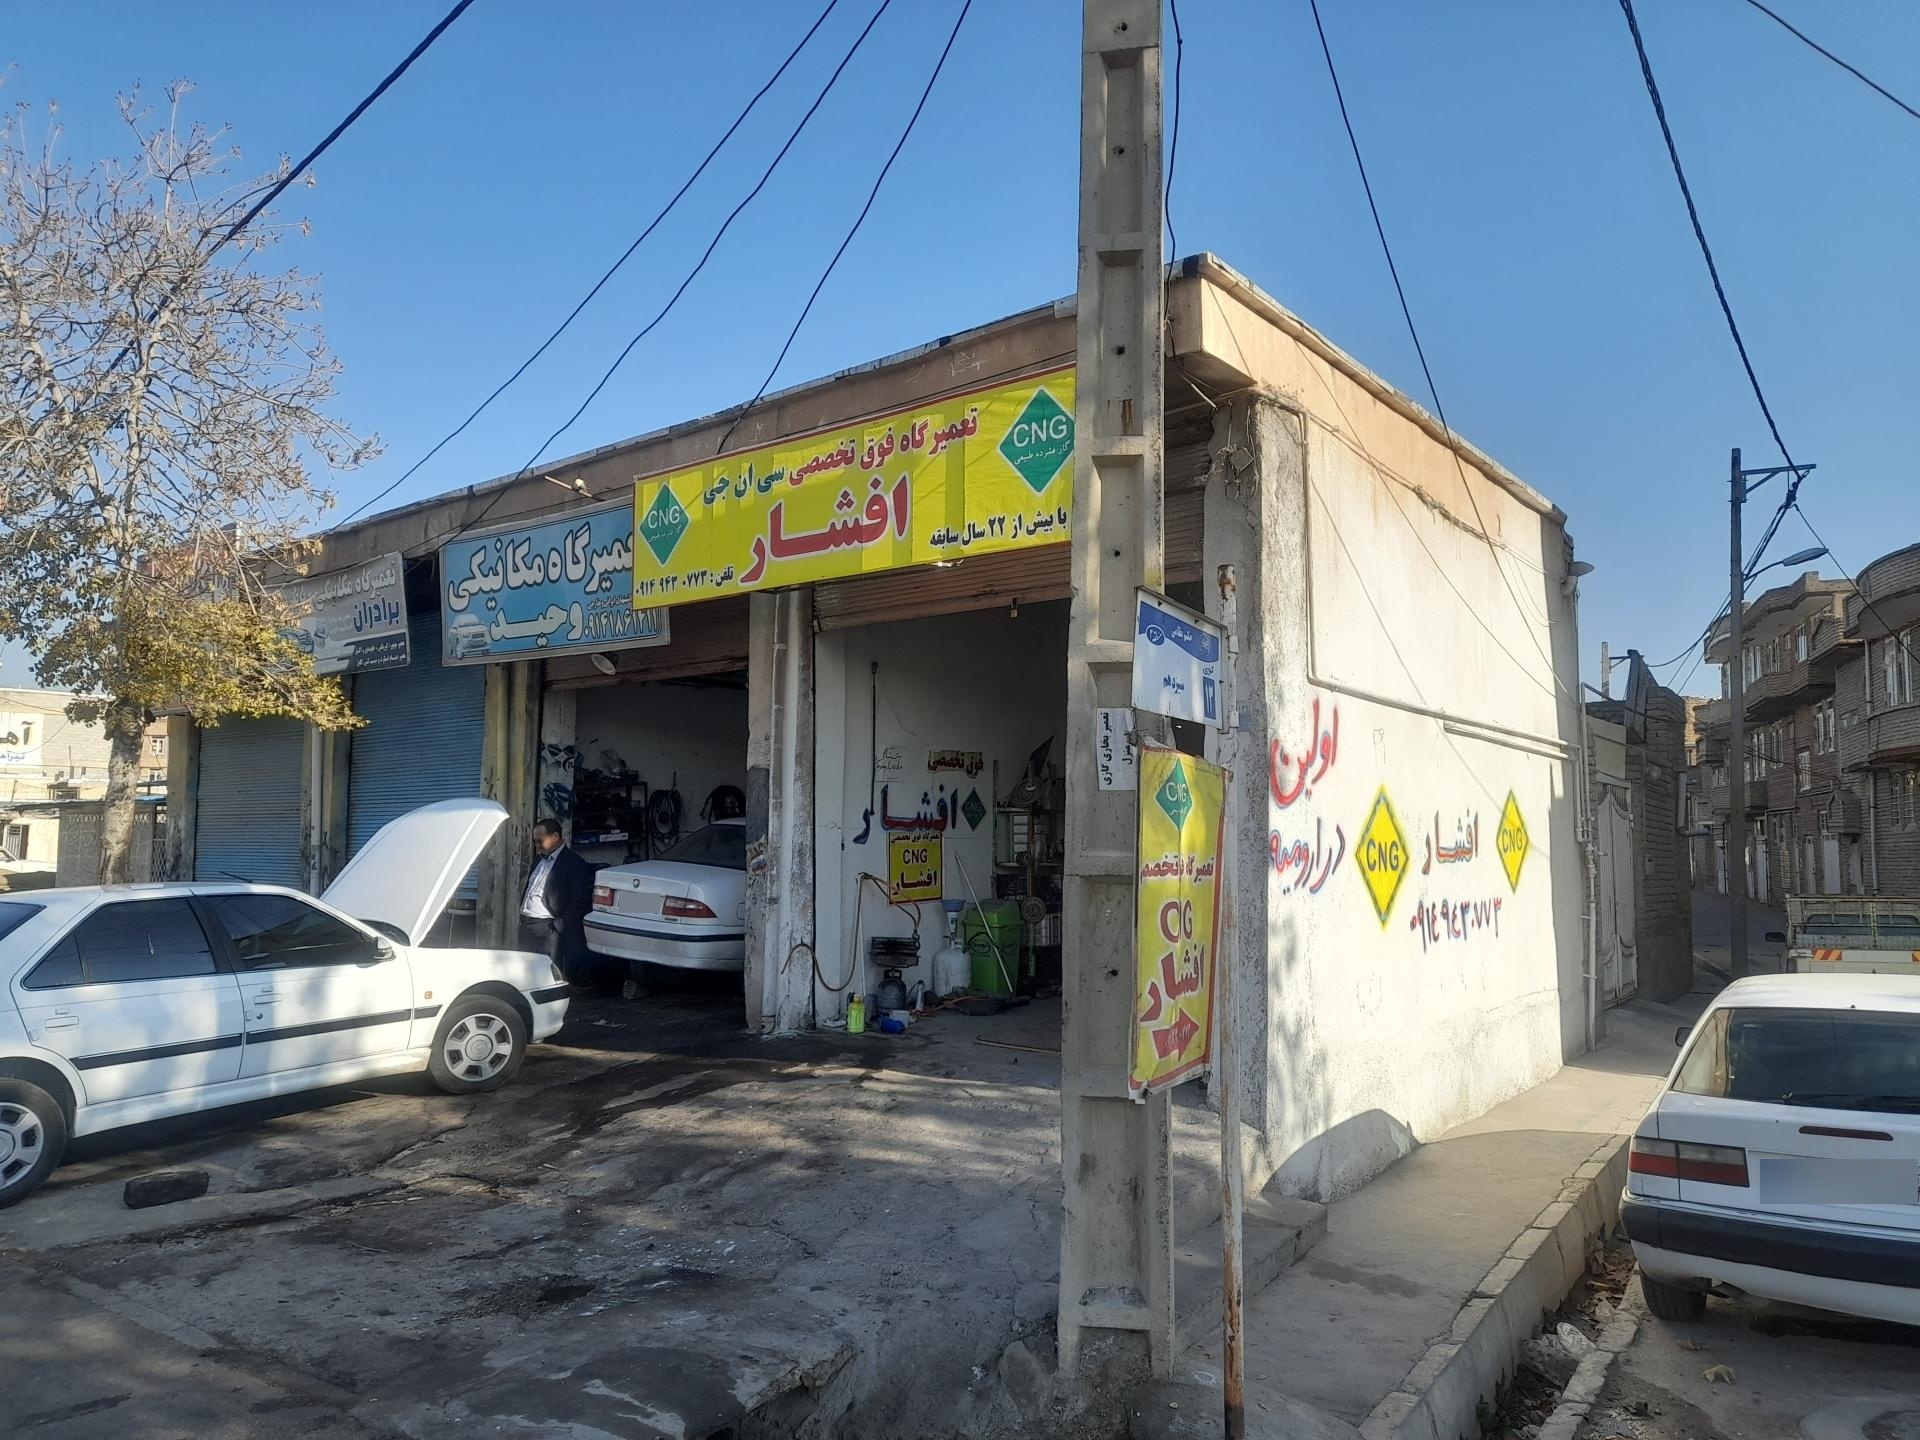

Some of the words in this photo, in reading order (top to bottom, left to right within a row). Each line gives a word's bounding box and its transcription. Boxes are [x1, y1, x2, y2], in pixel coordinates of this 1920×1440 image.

[1013, 414, 1068, 448] CNG
[788, 438, 857, 486] تخصصی
[860, 427, 895, 470] فوق
[703, 475, 730, 505] جی
[734, 463, 754, 498] ان
[757, 466, 785, 493] سی
[647, 505, 680, 529] CNG
[738, 474, 910, 585] افشار
[987, 515, 1006, 536] ۲۲
[1011, 514, 1023, 539] از
[1026, 510, 1054, 536] بیش
[1057, 507, 1067, 525] با
[929, 527, 959, 549] سابقه
[961, 522, 986, 547] سال
[448, 536, 545, 614] مکانیکی
[635, 578, 656, 596] ۰۹۱۴
[659, 575, 678, 594] ۹۴۳
[682, 569, 708, 587] ۰۷۷۳
[315, 574, 353, 612] مکانیکی
[352, 596, 400, 633] برادران
[489, 600, 584, 648] وحید
[1100, 711, 1112, 733] تعمیر
[1100, 735, 1113, 762] بخاری
[1269, 694, 1339, 809] اولین
[1100, 763, 1113, 786] گازی
[852, 782, 959, 846] افشار
[1422, 807, 1478, 875] افشار
[1501, 828, 1523, 854] CNG
[902, 848, 928, 865] CNG
[1366, 839, 1399, 873] CNG
[891, 869, 937, 896] افشار
[1140, 944, 1205, 1022] افشار
